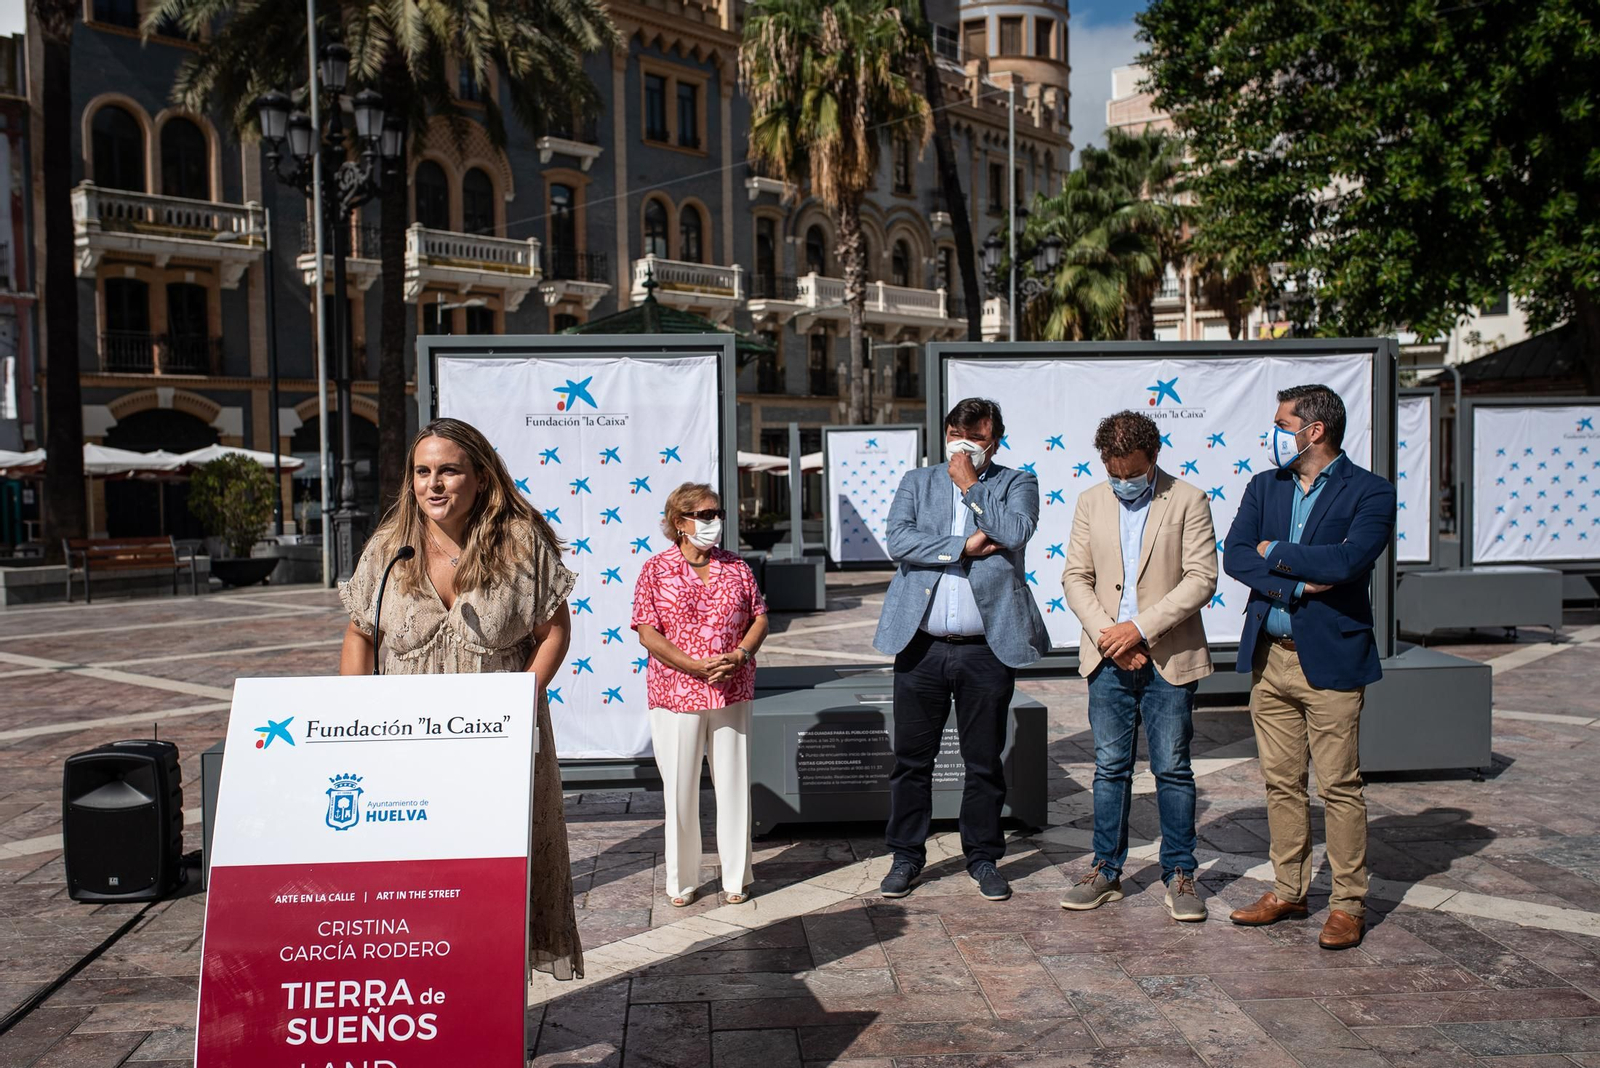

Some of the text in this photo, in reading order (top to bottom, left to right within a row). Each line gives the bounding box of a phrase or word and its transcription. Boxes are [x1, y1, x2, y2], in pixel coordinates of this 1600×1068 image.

[526, 416, 580, 426] Fundación
[596, 416, 629, 426] Caixa"
[306, 720, 413, 738] Fundación
[367, 799, 418, 809] Ayuntamiento
[366, 809, 428, 822] HUELVA
[274, 889, 460, 904] ARTE EN LA CALLE ART IN THE STREET
[318, 919, 410, 936] CRISTINA
[280, 940, 450, 962] GARCÍA RODERO
[281, 978, 446, 1010] TIERRA de
[286, 1007, 438, 1045] SUEÑOS
